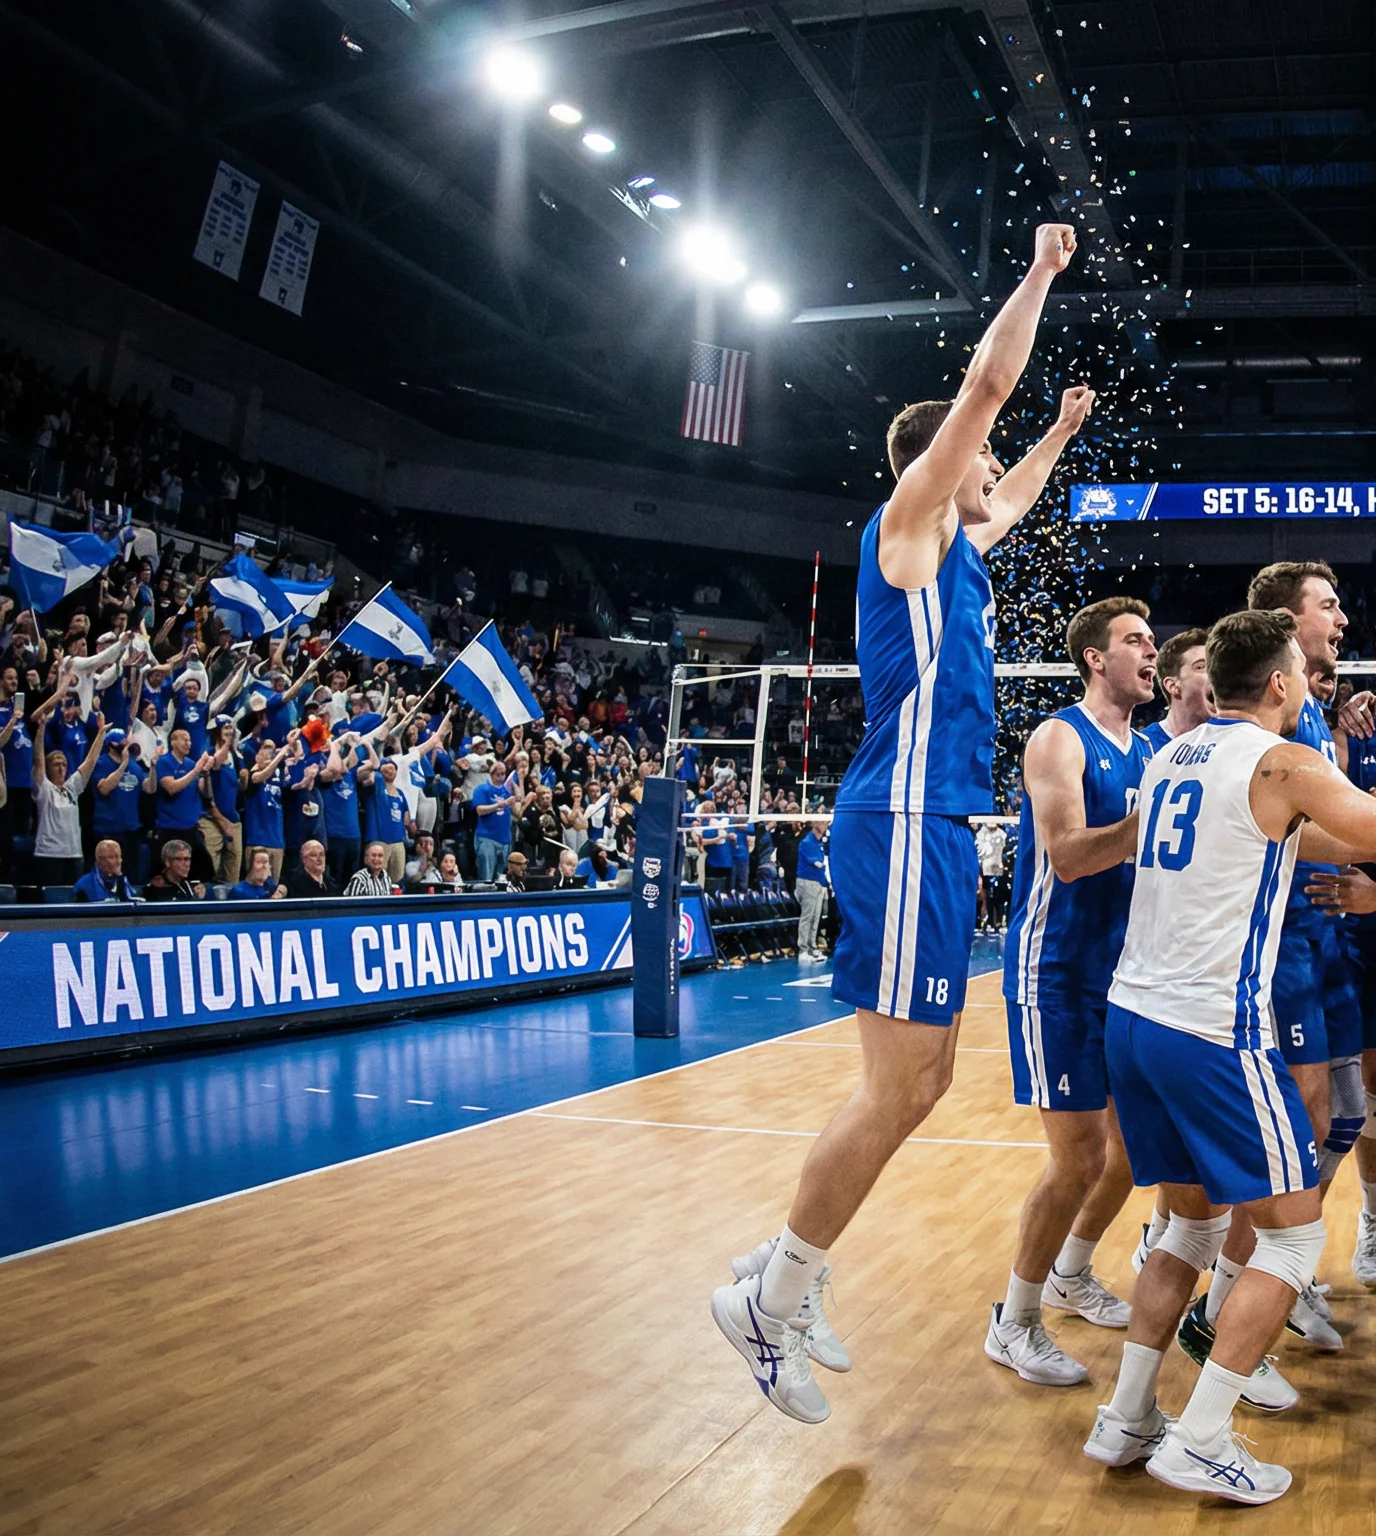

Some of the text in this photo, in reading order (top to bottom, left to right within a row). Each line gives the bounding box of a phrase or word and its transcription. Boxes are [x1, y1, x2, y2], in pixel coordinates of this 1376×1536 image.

[1203, 487, 1249, 514] SET
[1254, 487, 1278, 514] 5:
[1285, 487, 1360, 517] 16-14,
[1139, 778, 1204, 872] 13
[52, 928, 340, 1029] NATIONAL
[351, 912, 589, 994] CHAMPIONS
[925, 976, 949, 1006] 18
[1290, 1023, 1305, 1047] 5
[1057, 1073, 1071, 1096] 4
